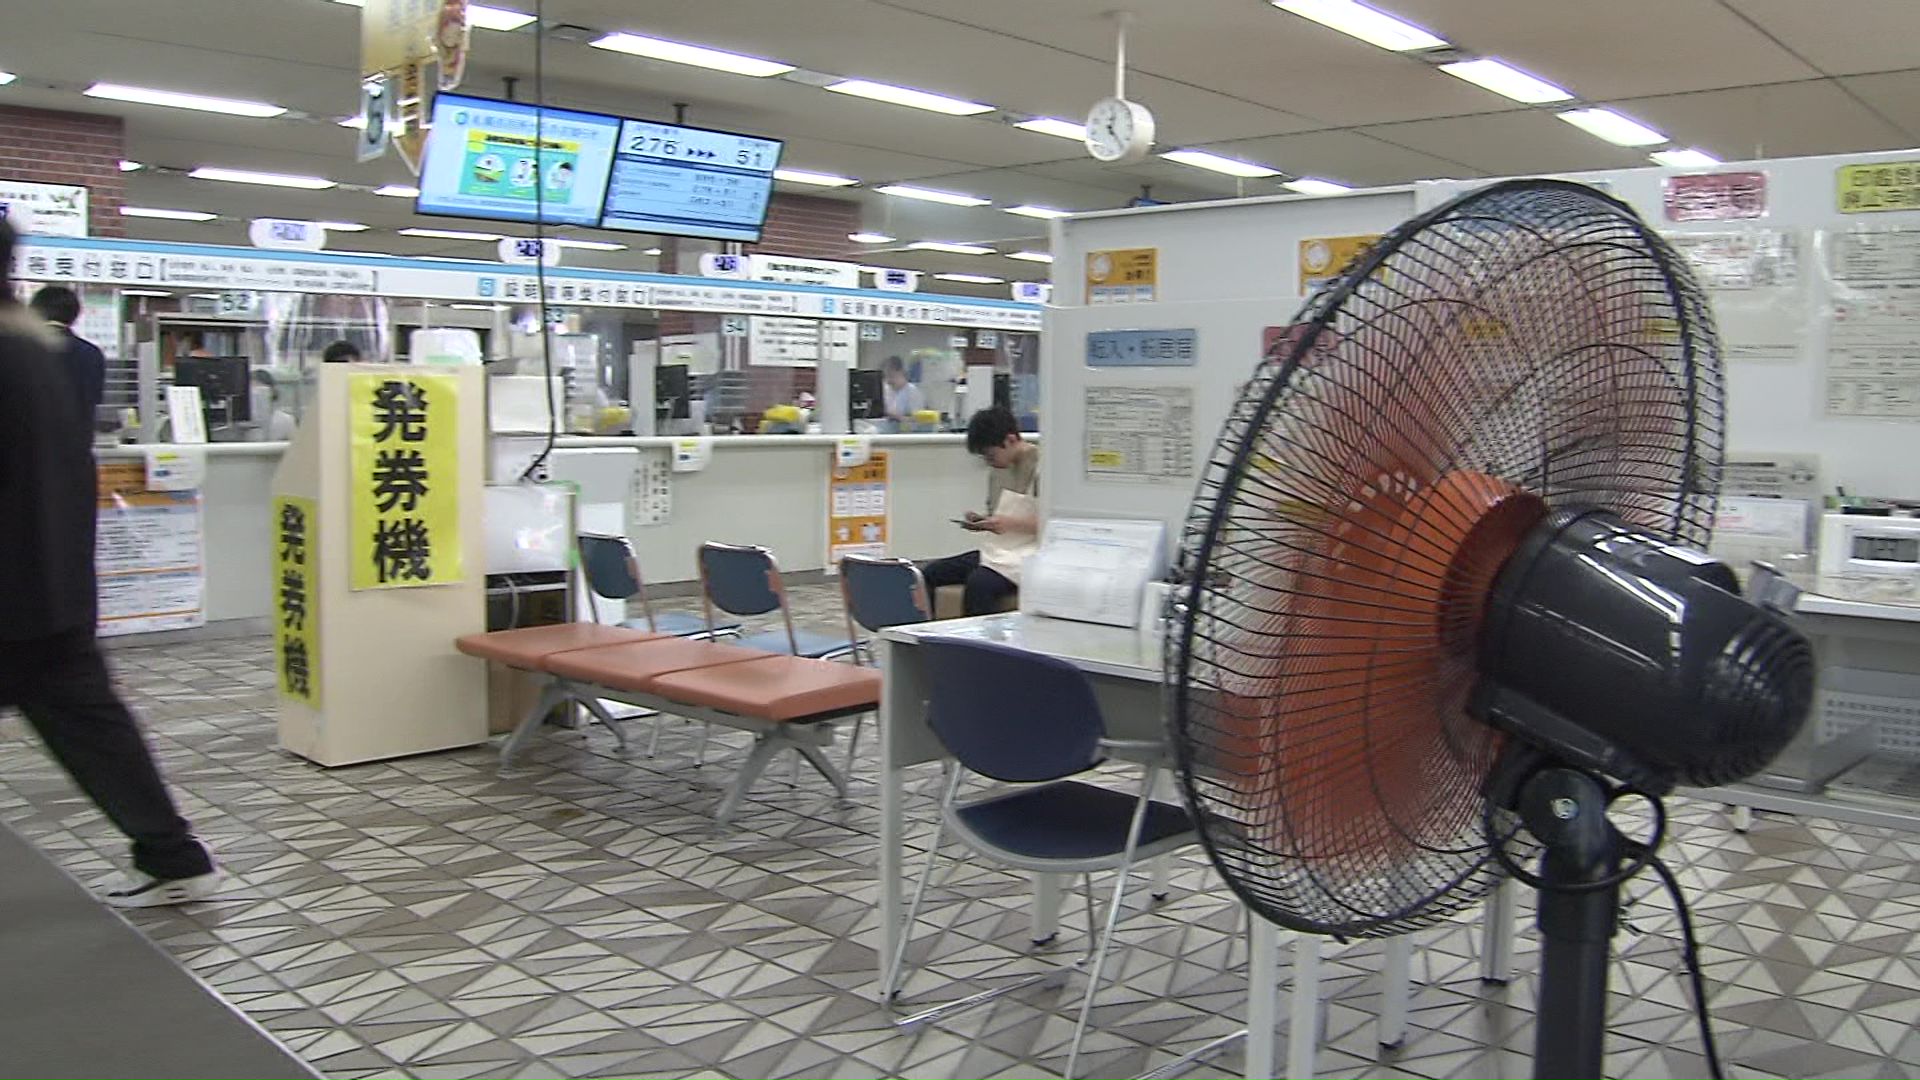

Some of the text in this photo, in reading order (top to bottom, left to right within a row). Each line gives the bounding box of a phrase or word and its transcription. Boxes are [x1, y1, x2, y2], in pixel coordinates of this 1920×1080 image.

[736, 150, 763, 167] 51
[221, 292, 250, 311] 52
[373, 380, 433, 584] 発券機
[280, 503, 310, 699] 発券機
